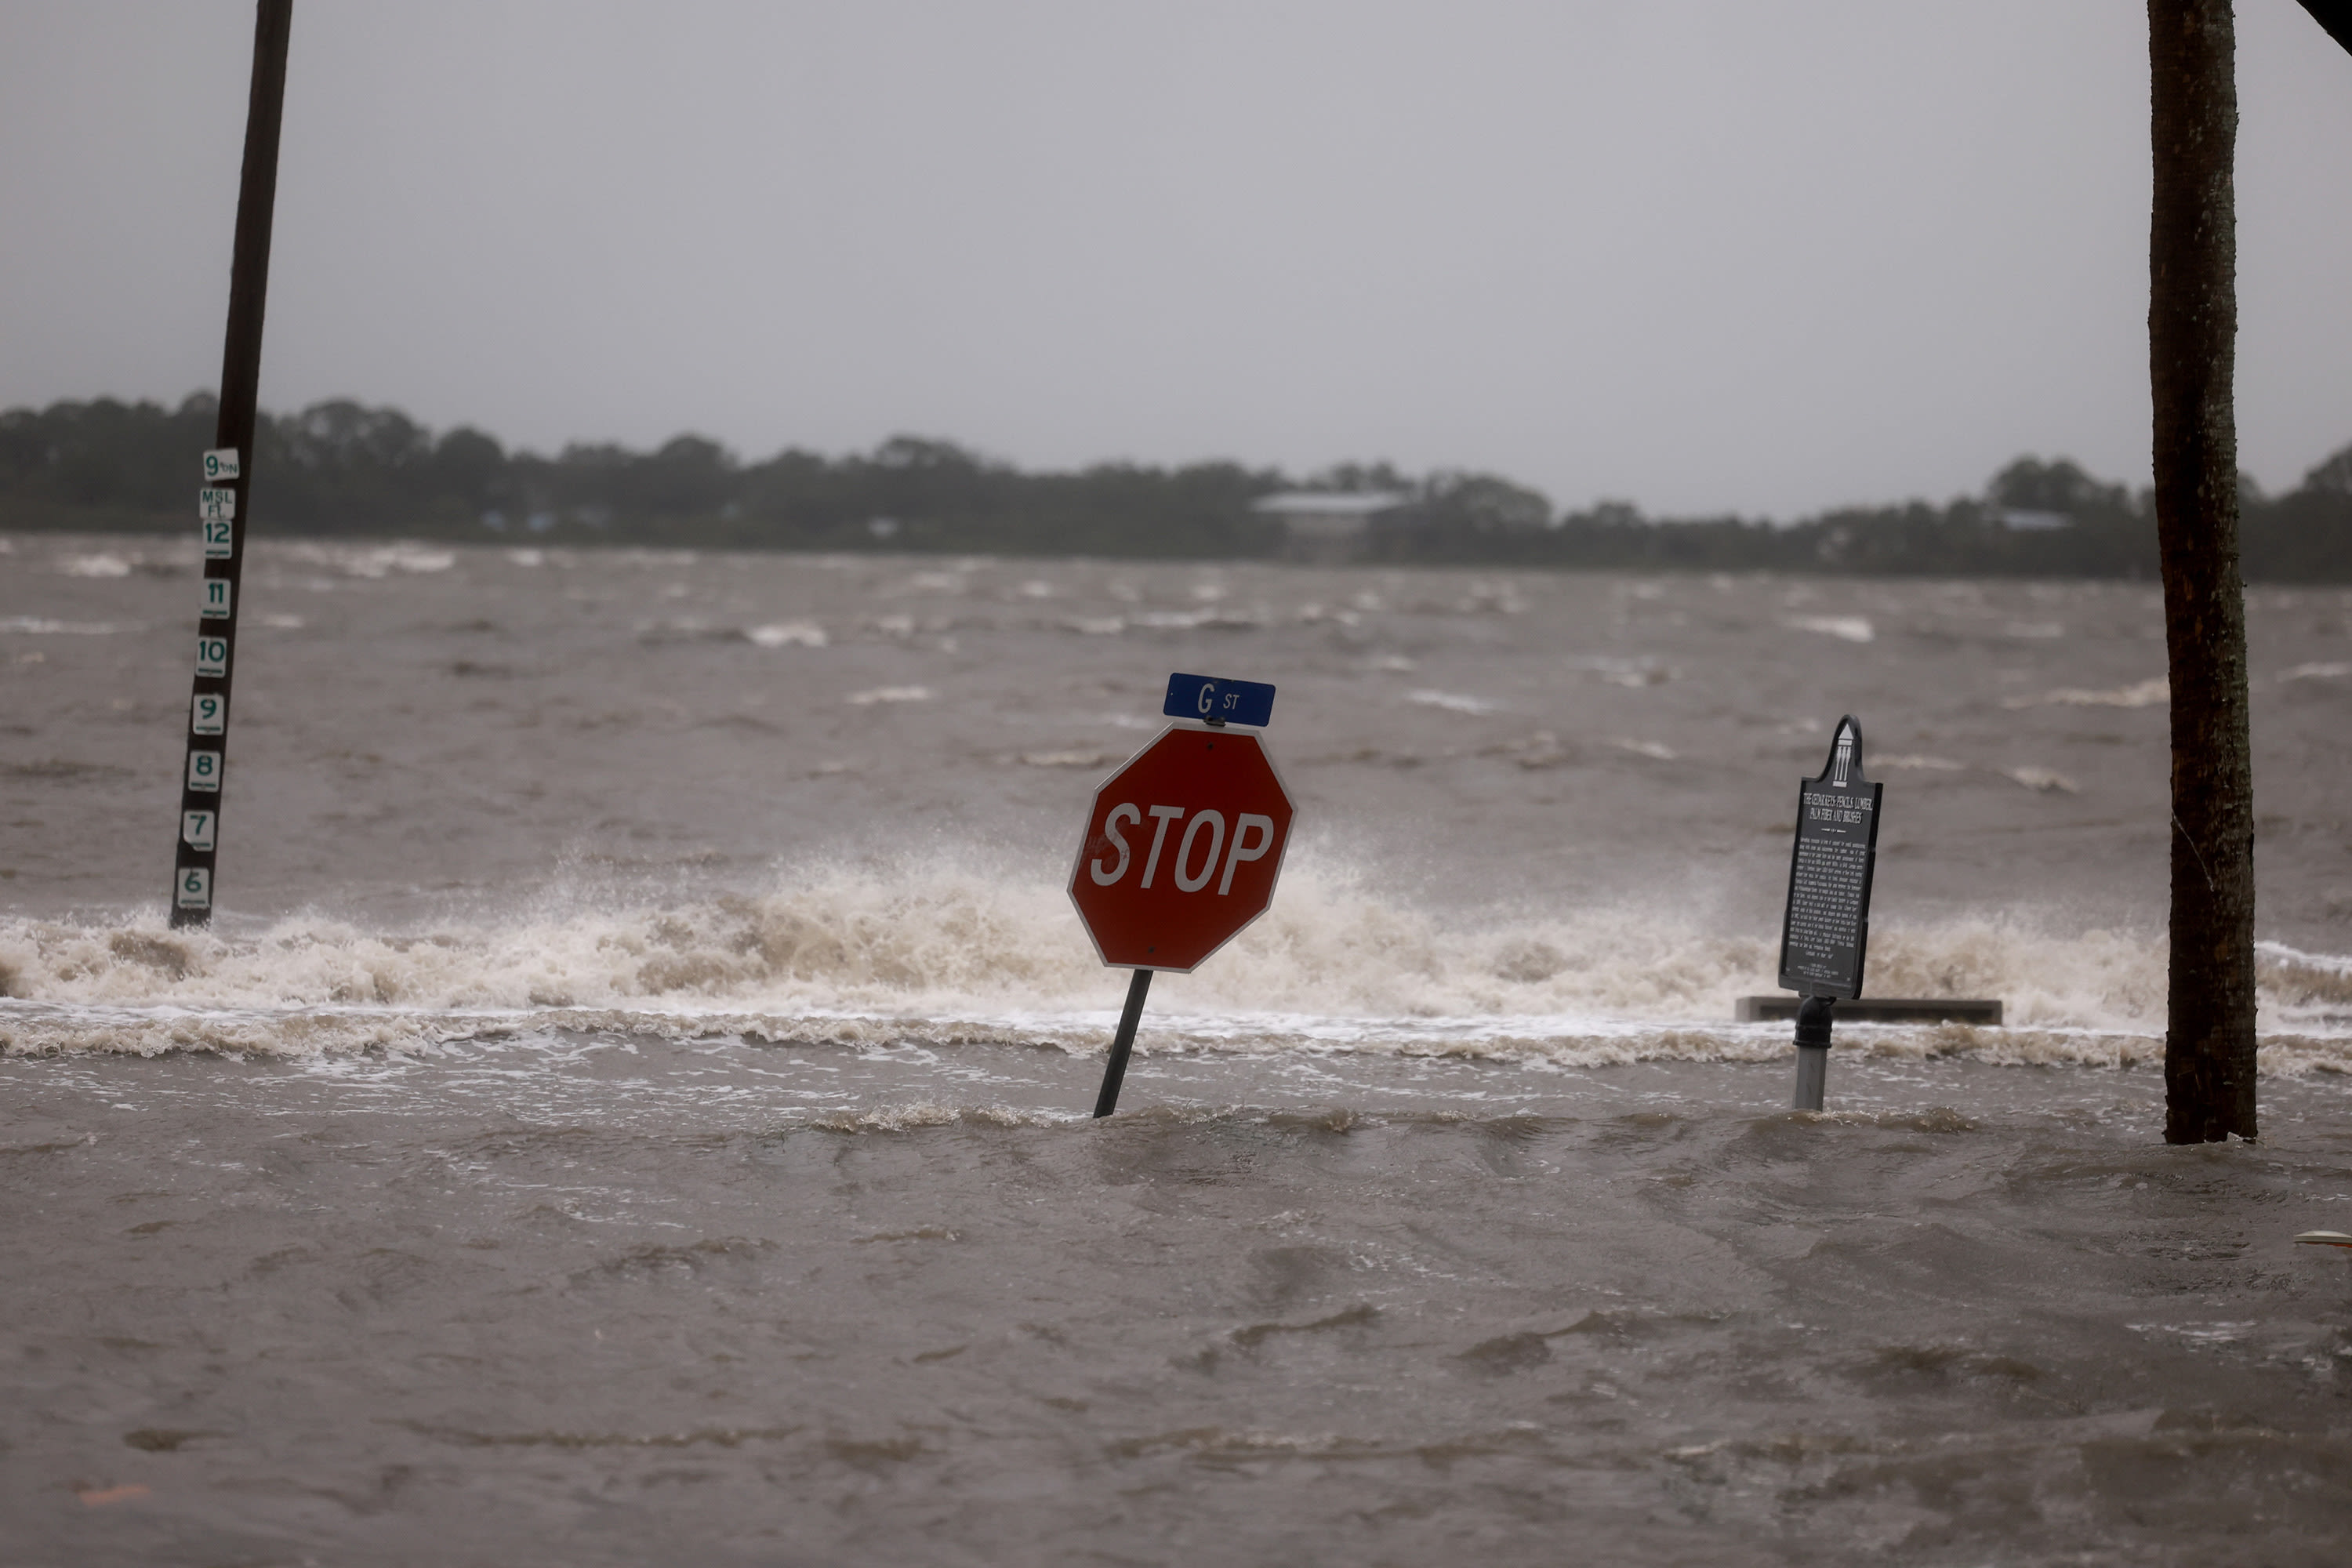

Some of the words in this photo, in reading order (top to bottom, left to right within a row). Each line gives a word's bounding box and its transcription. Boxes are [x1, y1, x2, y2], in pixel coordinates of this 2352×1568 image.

[201, 490, 233, 505] MSL
[205, 522, 230, 543] 12
[208, 583, 223, 603] 11
[199, 641, 225, 662] 10
[200, 699, 217, 719] 9
[1197, 683, 1215, 714] G
[1222, 693, 1240, 710] ST
[196, 755, 213, 776] 8
[190, 815, 207, 835] 7
[1091, 802, 1275, 896] STOP
[184, 871, 202, 893] 6
